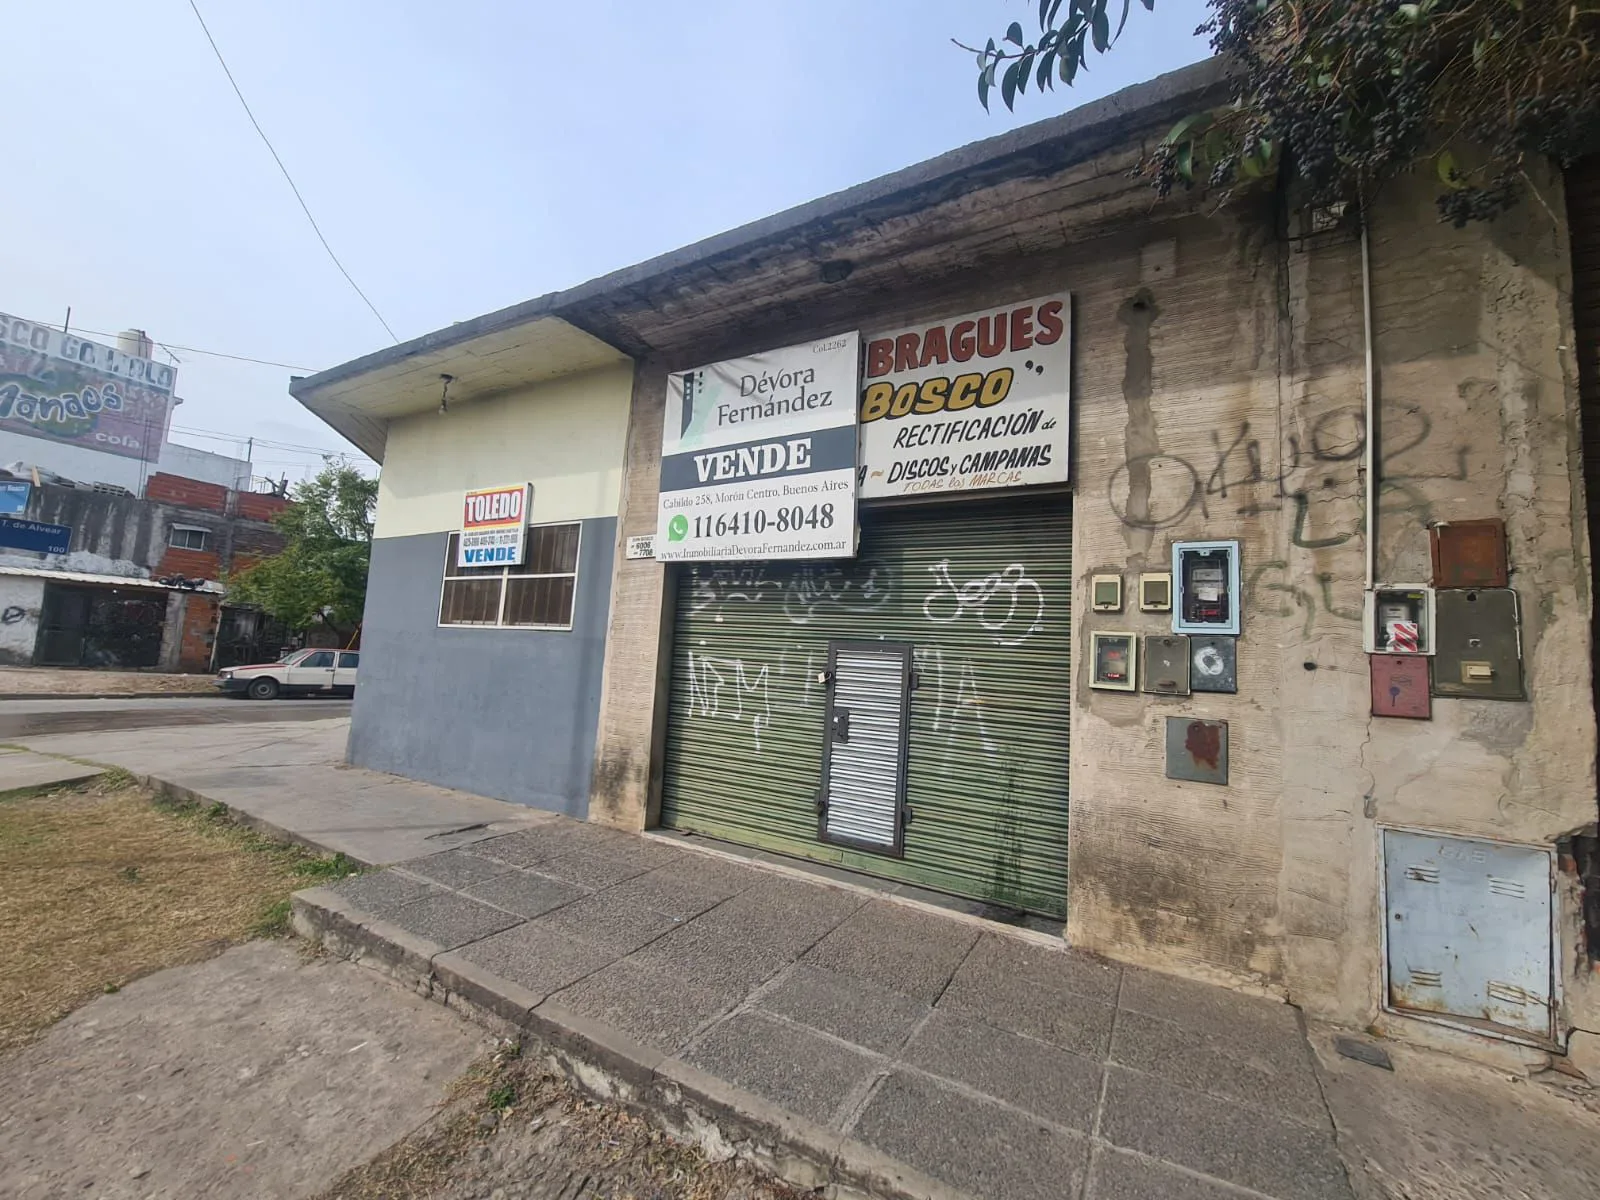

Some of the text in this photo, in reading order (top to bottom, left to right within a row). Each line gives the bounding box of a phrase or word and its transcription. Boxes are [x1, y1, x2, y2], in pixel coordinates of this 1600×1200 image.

[739, 367, 816, 398] Dévora
[859, 367, 1015, 425] BOSCO
[717, 385, 833, 427] Fernández
[694, 438, 812, 483] VENDE
[887, 455, 950, 484] DISCOS
[958, 444, 1052, 476] CAMPANAS
[783, 484, 818, 496] Buenos
[821, 480, 849, 492] Aires
[903, 478, 944, 493] TODAS
[968, 470, 1022, 488] MARCAS
[466, 491, 521, 522] TOLEDO
[693, 503, 834, 538] 116410-8048
[28, 523, 62, 534] Alvear
[48, 545, 65, 553] 100
[464, 546, 516, 563] VENDE
